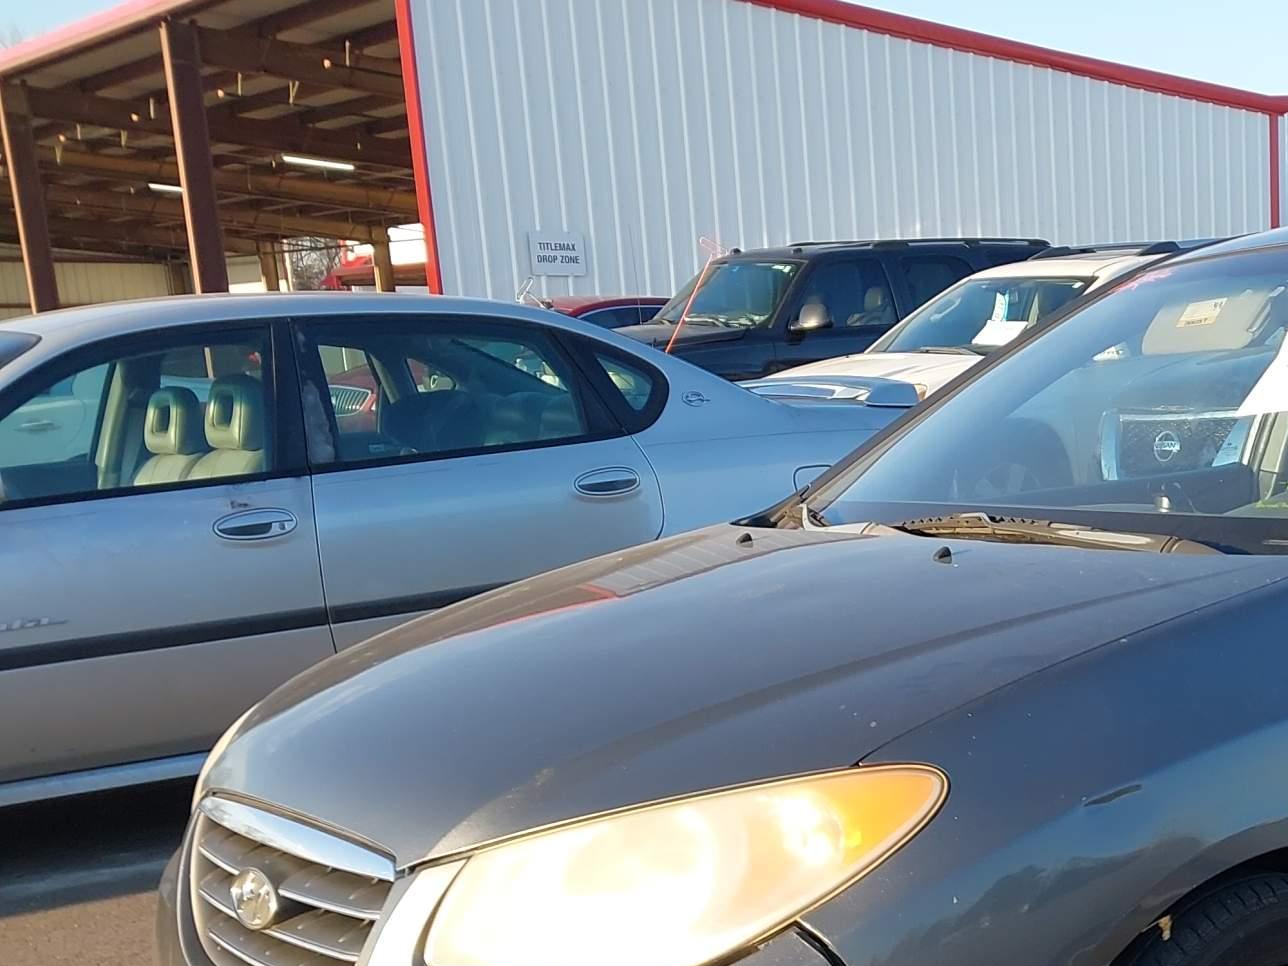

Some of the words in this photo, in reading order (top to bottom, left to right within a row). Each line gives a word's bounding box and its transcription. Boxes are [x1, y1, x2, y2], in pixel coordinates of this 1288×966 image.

[537, 242, 576, 251] TITLEMAX
[537, 254, 557, 264] DROP
[560, 255, 580, 264] ZONE
